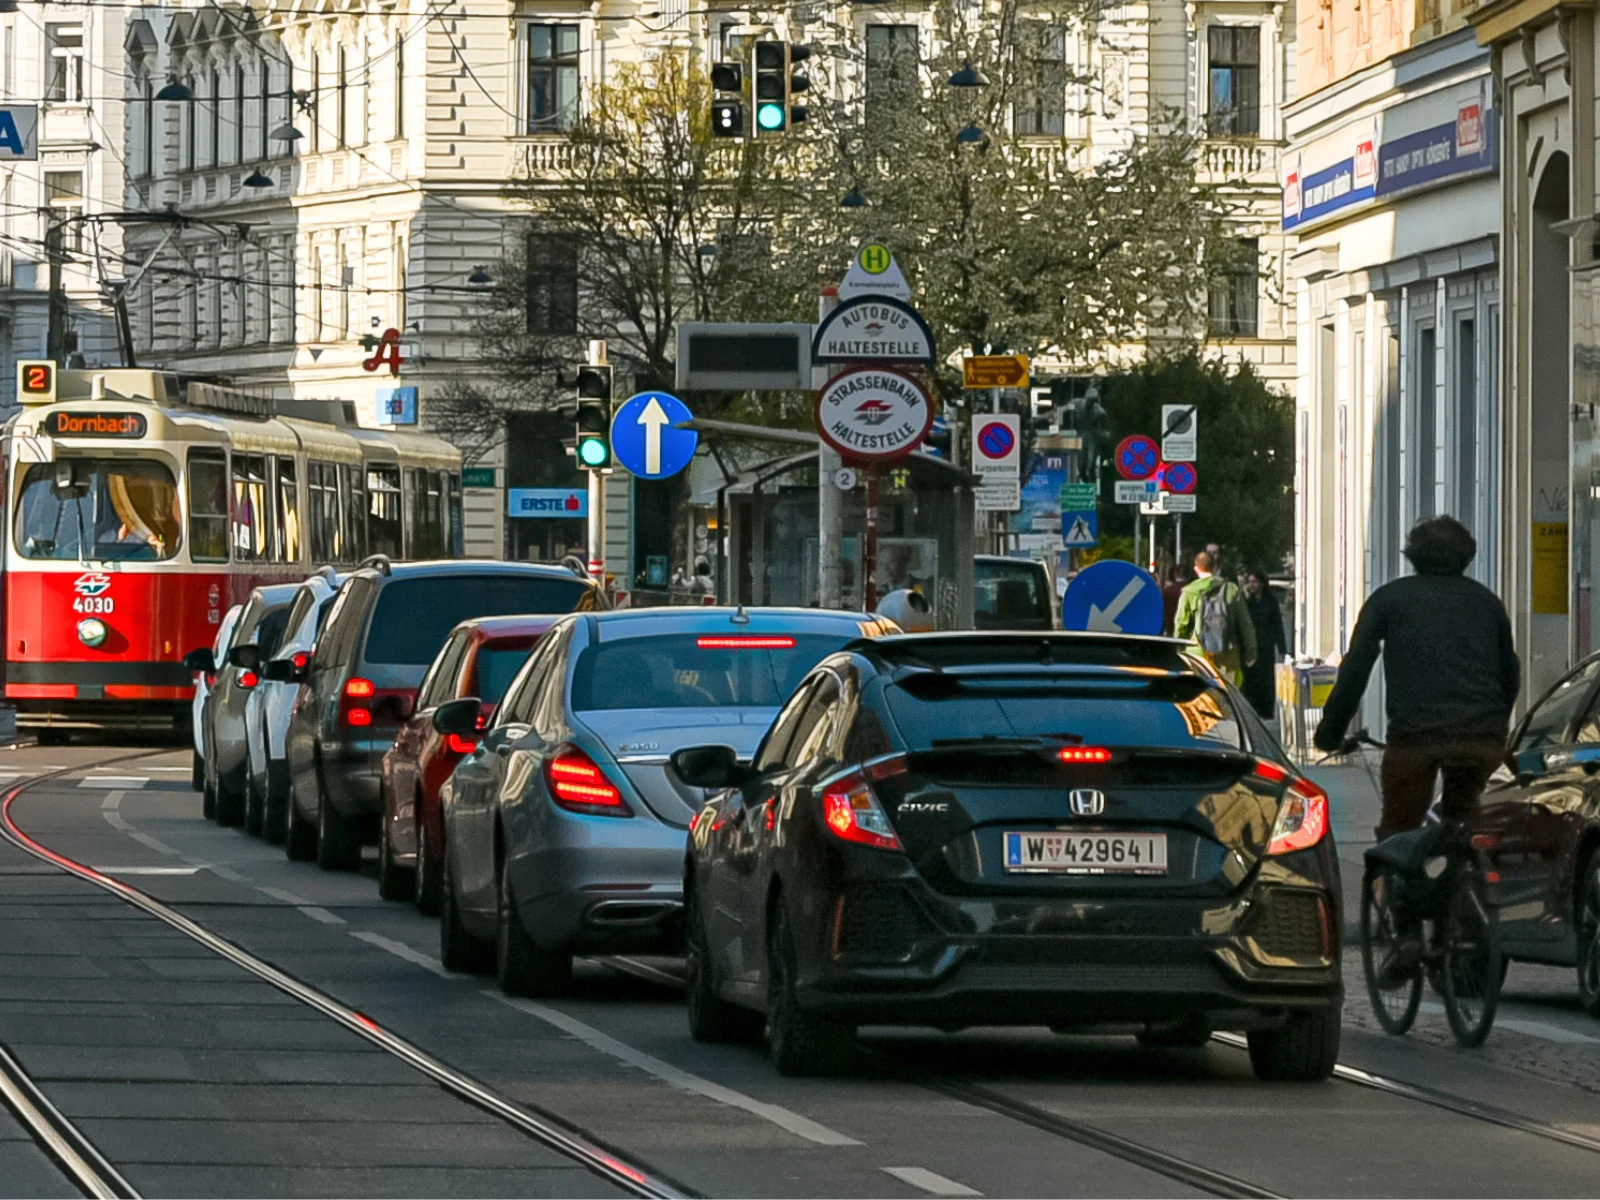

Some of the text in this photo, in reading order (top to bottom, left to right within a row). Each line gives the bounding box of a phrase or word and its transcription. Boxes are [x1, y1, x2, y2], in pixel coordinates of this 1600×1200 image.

[866, 249, 884, 269] H
[841, 306, 909, 330] AUTOBUS
[828, 341, 920, 355] HALTESTELLE
[28, 367, 45, 389] 2
[827, 375, 920, 409] STRASSENBAHN
[57, 413, 139, 433] Dornbach
[830, 420, 916, 449] HALTESTELLE
[840, 472, 851, 486] 2
[521, 498, 563, 511] ERSTE
[72, 597, 114, 613] 4030
[897, 803, 948, 811] CIVIC
[1027, 837, 1045, 862] W
